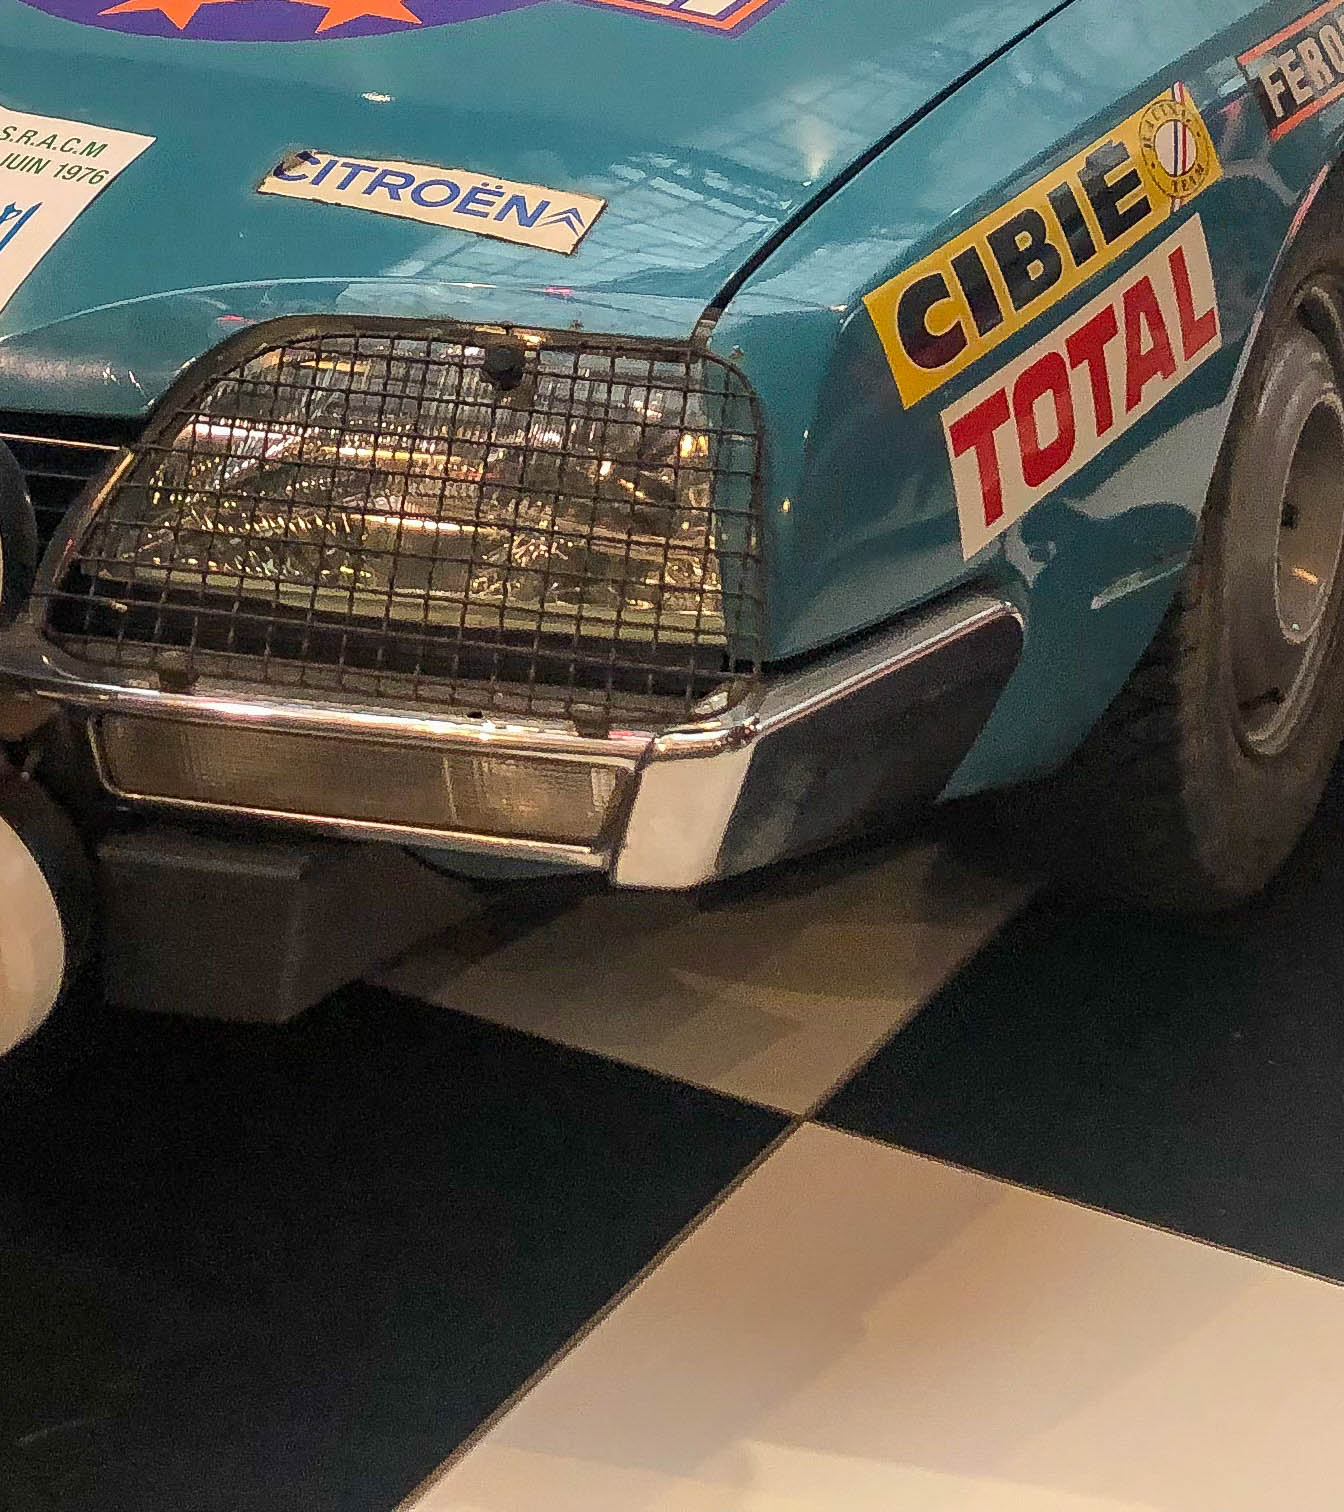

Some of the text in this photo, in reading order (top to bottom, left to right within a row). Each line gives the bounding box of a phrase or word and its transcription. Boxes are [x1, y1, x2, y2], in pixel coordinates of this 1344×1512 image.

[52, 162, 110, 186] 1976
[272, 150, 551, 229] CITROËN
[948, 245, 1218, 528] TOTAL
